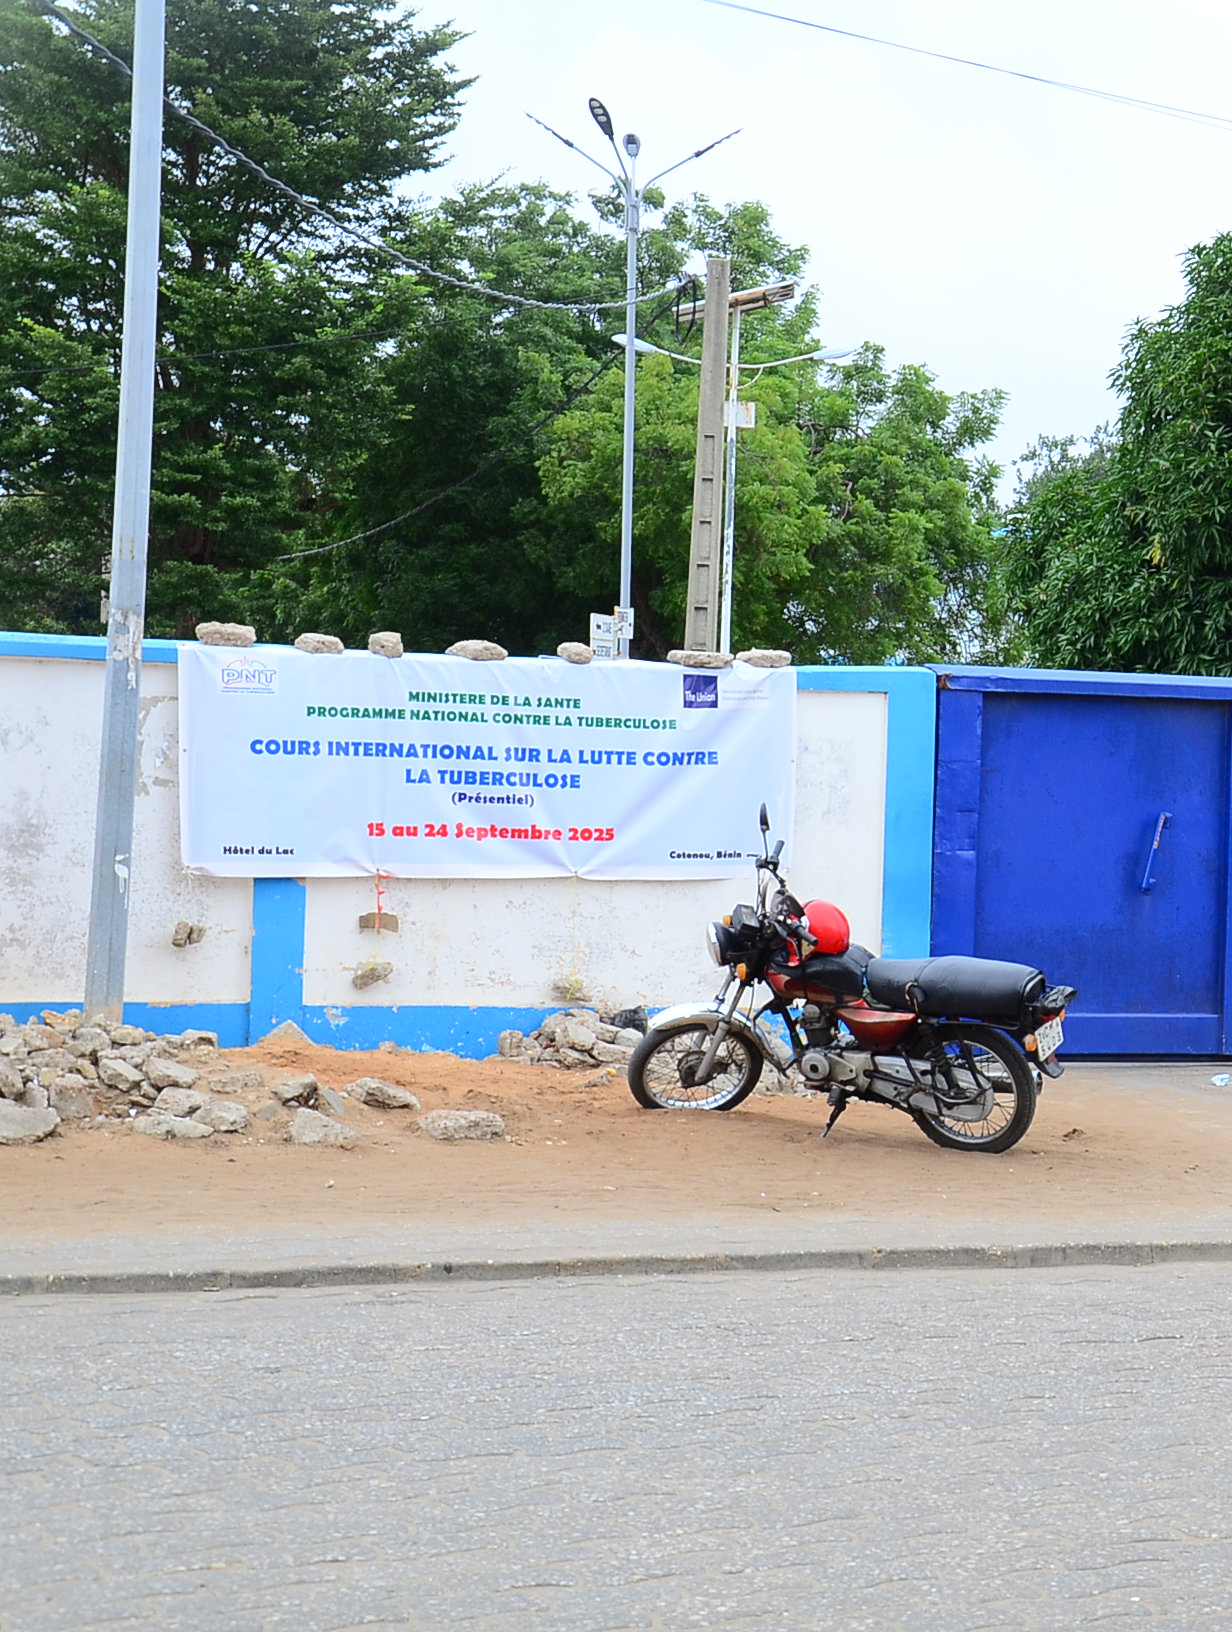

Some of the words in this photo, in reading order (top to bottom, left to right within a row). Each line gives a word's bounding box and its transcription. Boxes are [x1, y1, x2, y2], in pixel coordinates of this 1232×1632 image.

[221, 668, 277, 685] PNT
[408, 690, 487, 705] MINISTERE
[490, 694, 510, 707] DE
[513, 695, 533, 708] LA
[536, 696, 581, 710] SANTE
[684, 690, 696, 702] The
[696, 691, 716, 702] Union
[306, 705, 406, 720] PROGRAMME
[409, 709, 489, 724] NATIONAL
[492, 712, 551, 726] CONTRE
[554, 715, 573, 727] LA
[576, 716, 677, 730] TUBERCULOSE
[249, 738, 321, 757] COURS
[327, 740, 499, 762] INTERNATIONAL
[504, 746, 542, 763] SUR
[547, 748, 573, 764] LA
[578, 749, 637, 766] LUTTE
[642, 751, 719, 767] CONTRE
[405, 768, 432, 784] LA
[437, 769, 581, 790] TUBERCULOSE
[451, 791, 535, 808] (Présentiel)
[367, 822, 386, 837] 15
[391, 825, 419, 837] au
[424, 823, 449, 838] 24
[454, 822, 563, 841] Septembre
[568, 827, 615, 842] 2025
[223, 845, 255, 855] Hôtel
[257, 845, 273, 855] du
[275, 846, 295, 856] Lac
[669, 850, 714, 861] Cotonou,
[716, 850, 742, 859] Bénin
